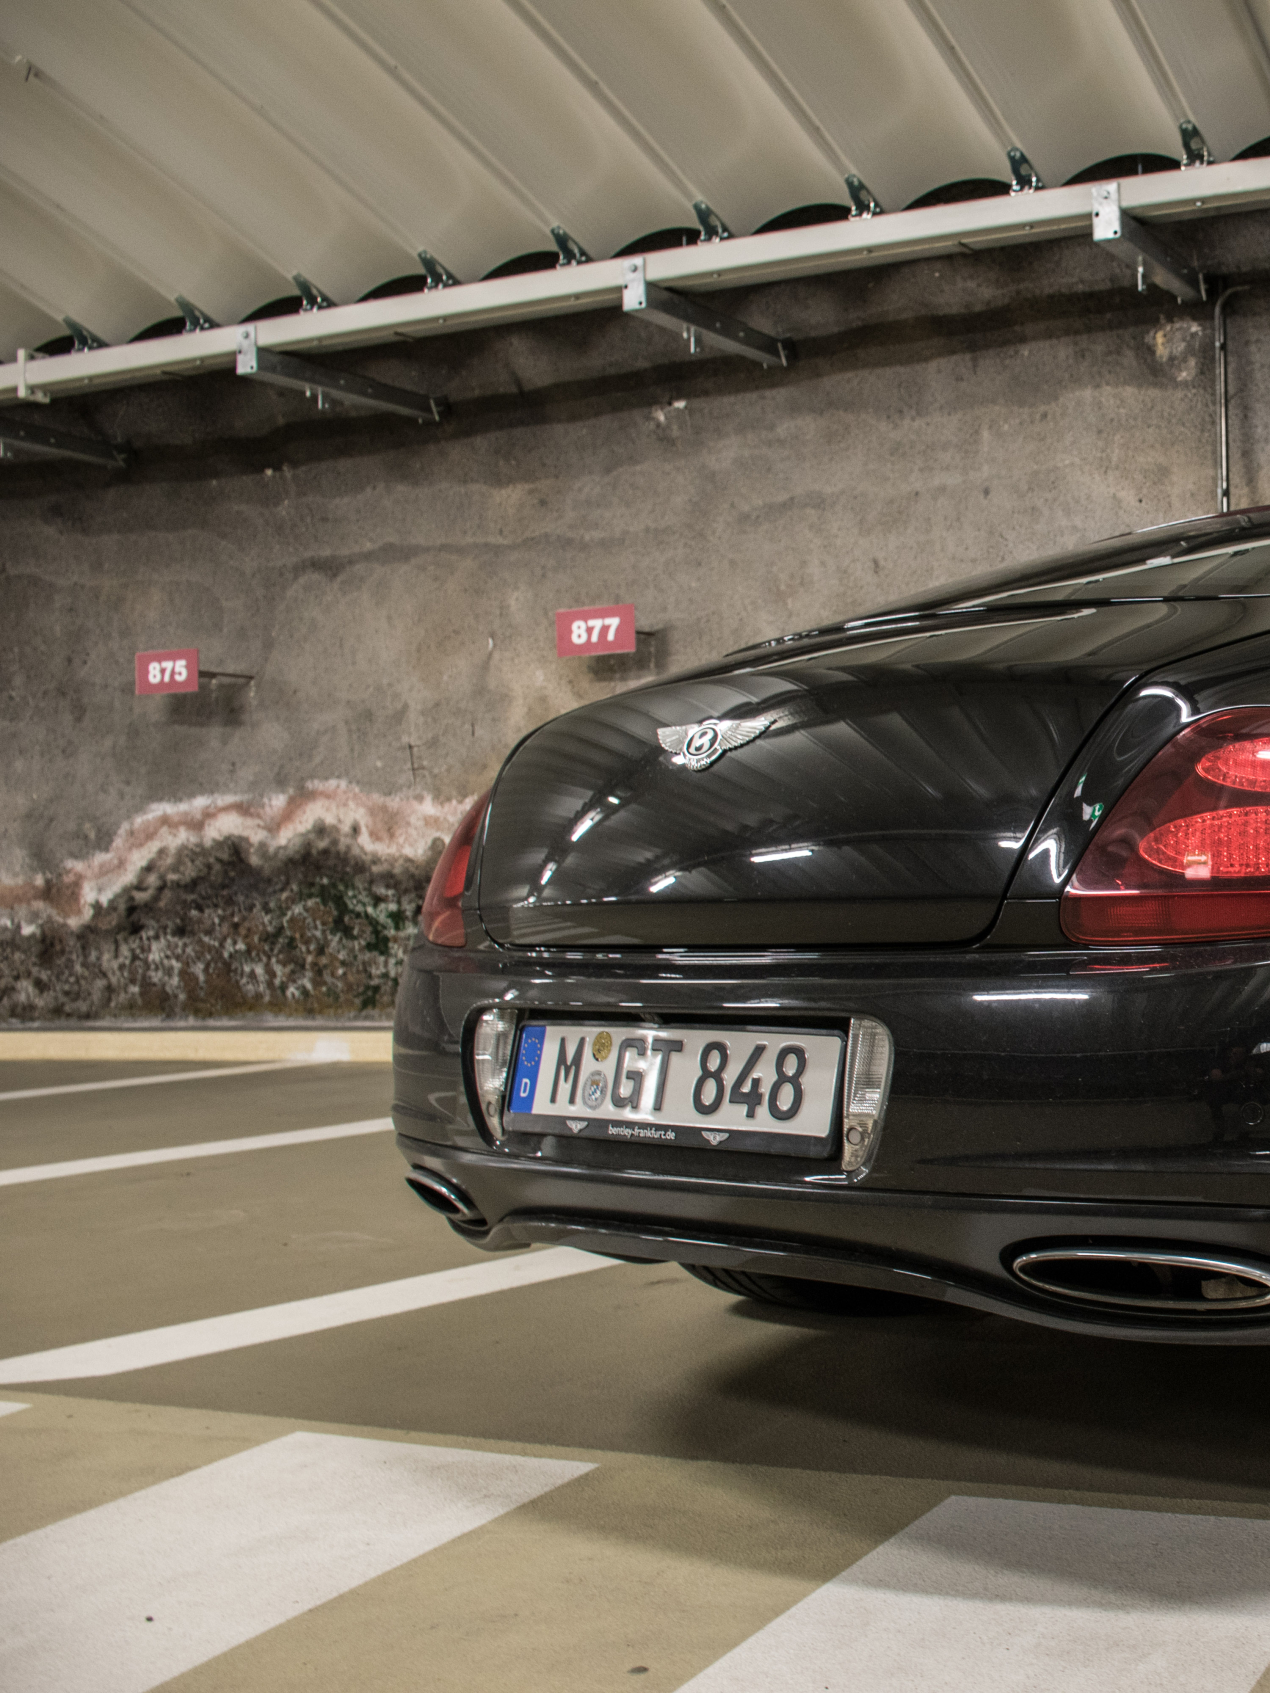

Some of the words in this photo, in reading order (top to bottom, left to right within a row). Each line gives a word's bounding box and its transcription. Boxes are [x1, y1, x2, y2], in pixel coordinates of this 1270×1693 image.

[571, 617, 621, 645] 877
[147, 659, 188, 684] 875
[520, 1078, 530, 1098] D
[549, 1036, 586, 1105] M
[610, 1038, 684, 1111] GT
[693, 1042, 808, 1121] 848
[608, 1124, 676, 1141] bentley-frankfurt.de
